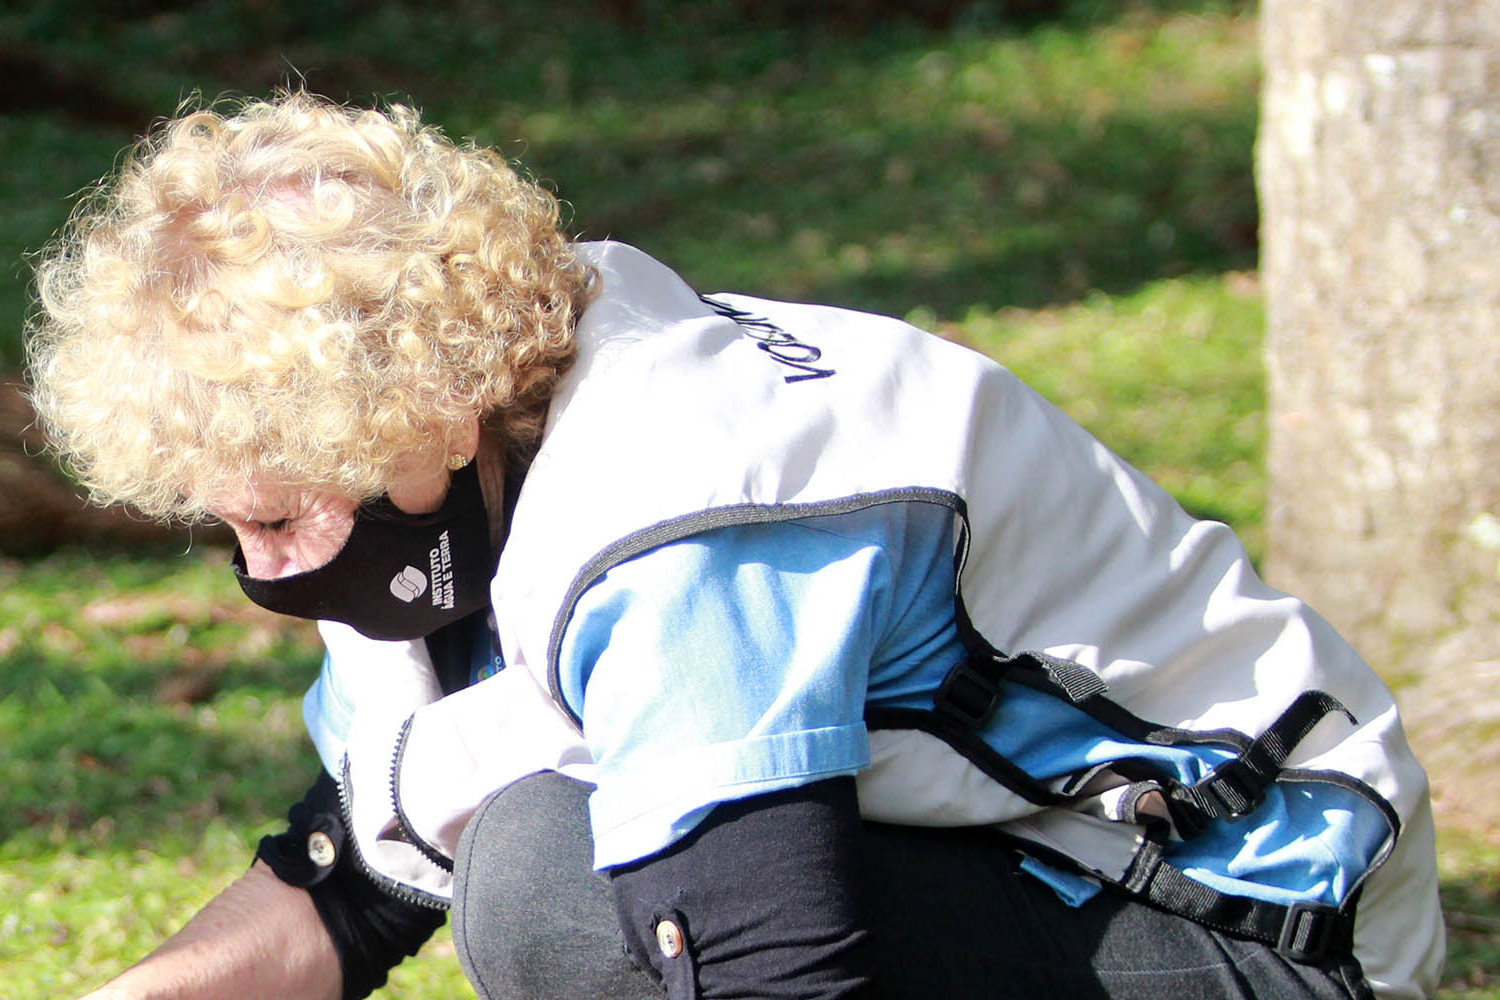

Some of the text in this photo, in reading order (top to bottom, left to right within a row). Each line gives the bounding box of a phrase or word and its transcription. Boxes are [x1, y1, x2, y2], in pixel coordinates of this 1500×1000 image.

[439, 530, 452, 573] TERRA
[429, 547, 443, 606] INSTITUTO
[443, 571, 453, 582] E
